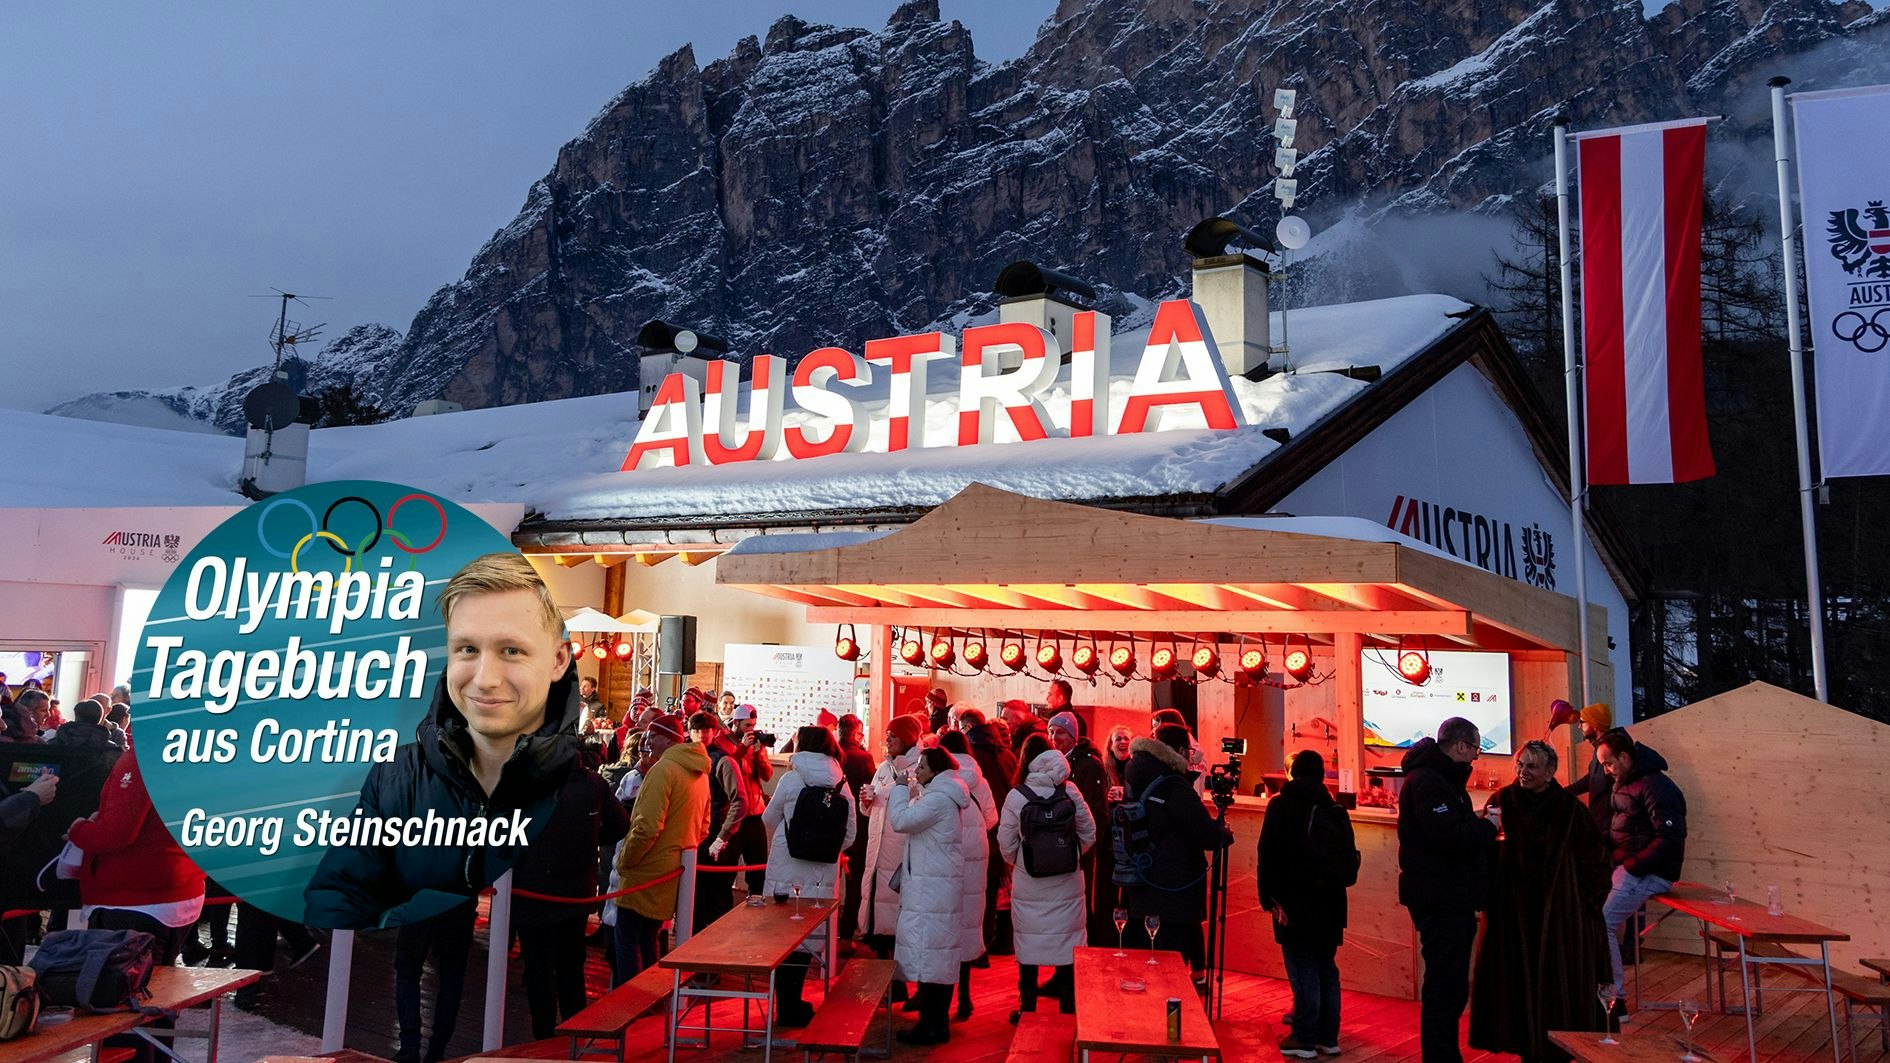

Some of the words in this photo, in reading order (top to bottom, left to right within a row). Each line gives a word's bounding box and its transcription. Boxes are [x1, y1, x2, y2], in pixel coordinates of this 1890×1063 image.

[619, 299, 1240, 472] AUSTRIA
[102, 531, 161, 548] AUSTRIA
[109, 547, 155, 557] HOUSE
[1387, 495, 1518, 580] AUSTRIA
